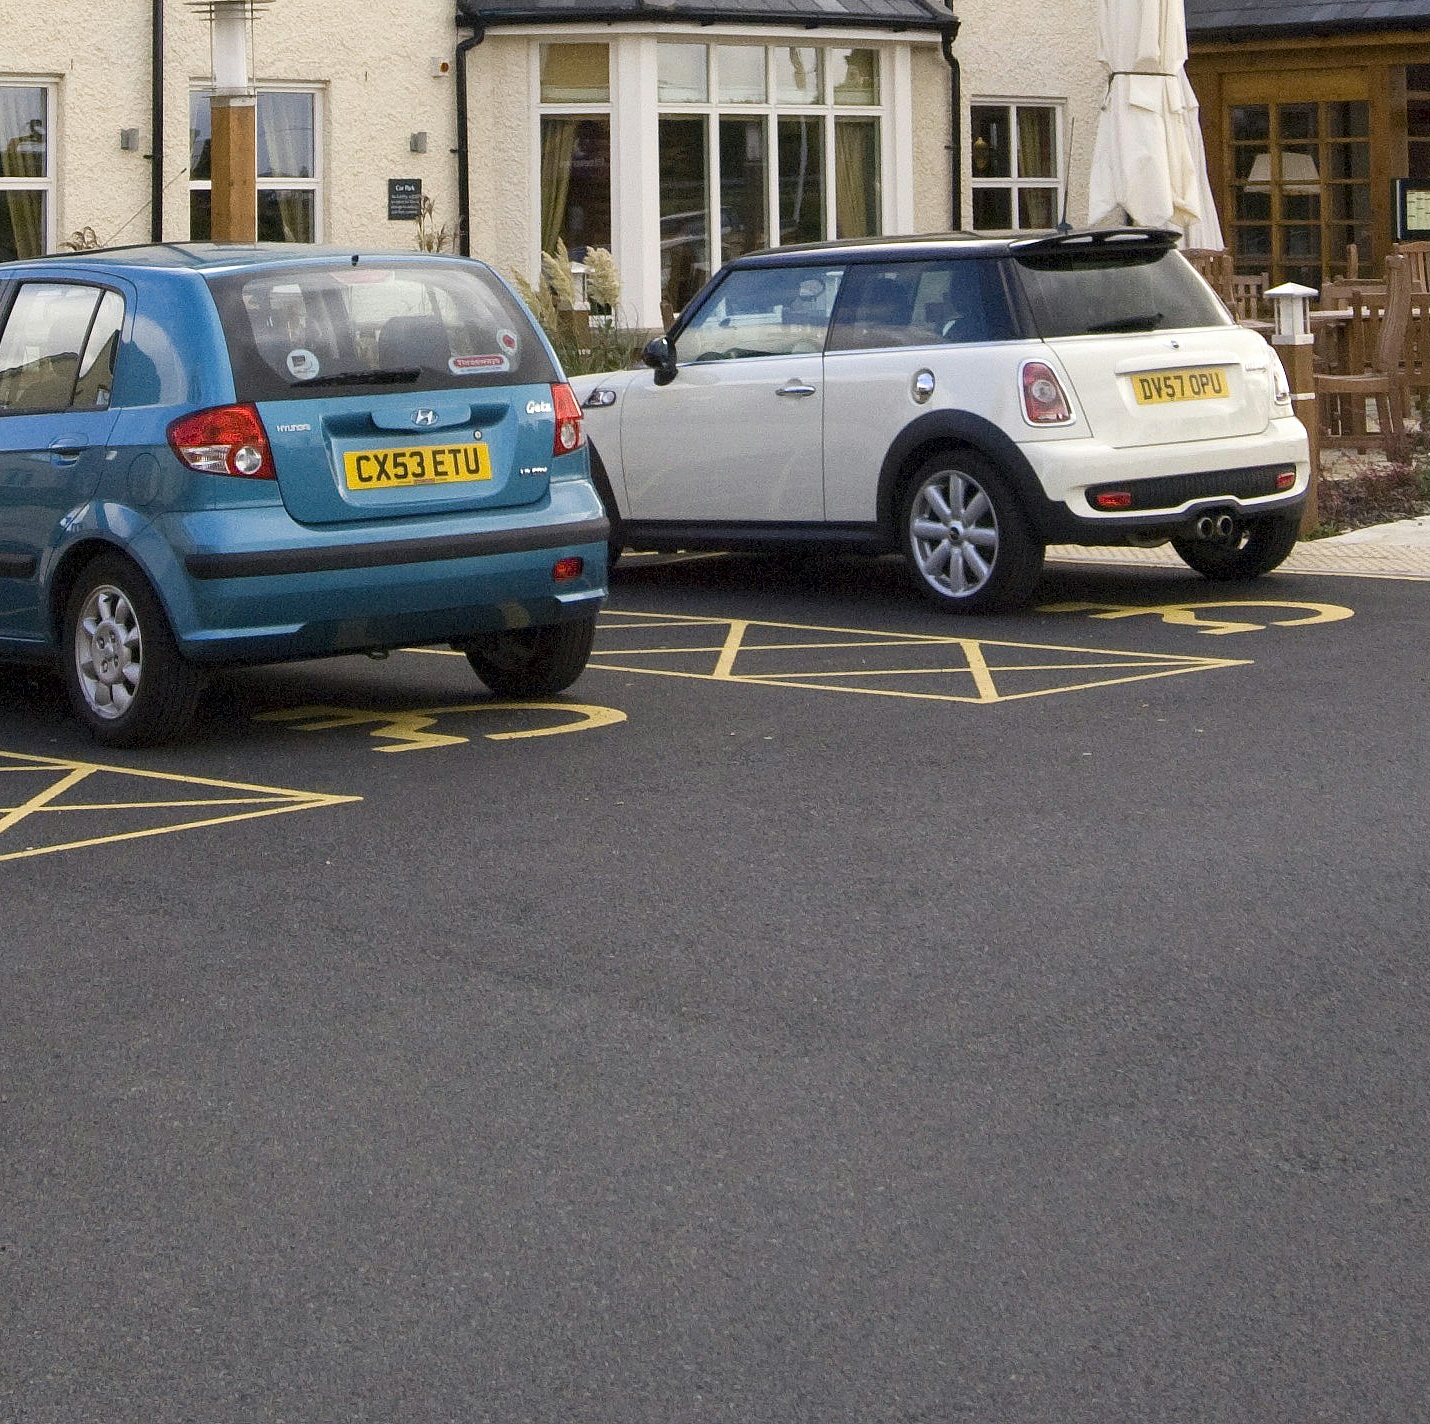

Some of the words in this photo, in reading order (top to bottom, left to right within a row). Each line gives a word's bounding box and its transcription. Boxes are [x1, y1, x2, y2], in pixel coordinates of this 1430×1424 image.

[1138, 375, 1186, 400] DV57
[1188, 372, 1223, 396] OPU
[355, 451, 426, 483] CX53
[431, 447, 481, 477] ETU
